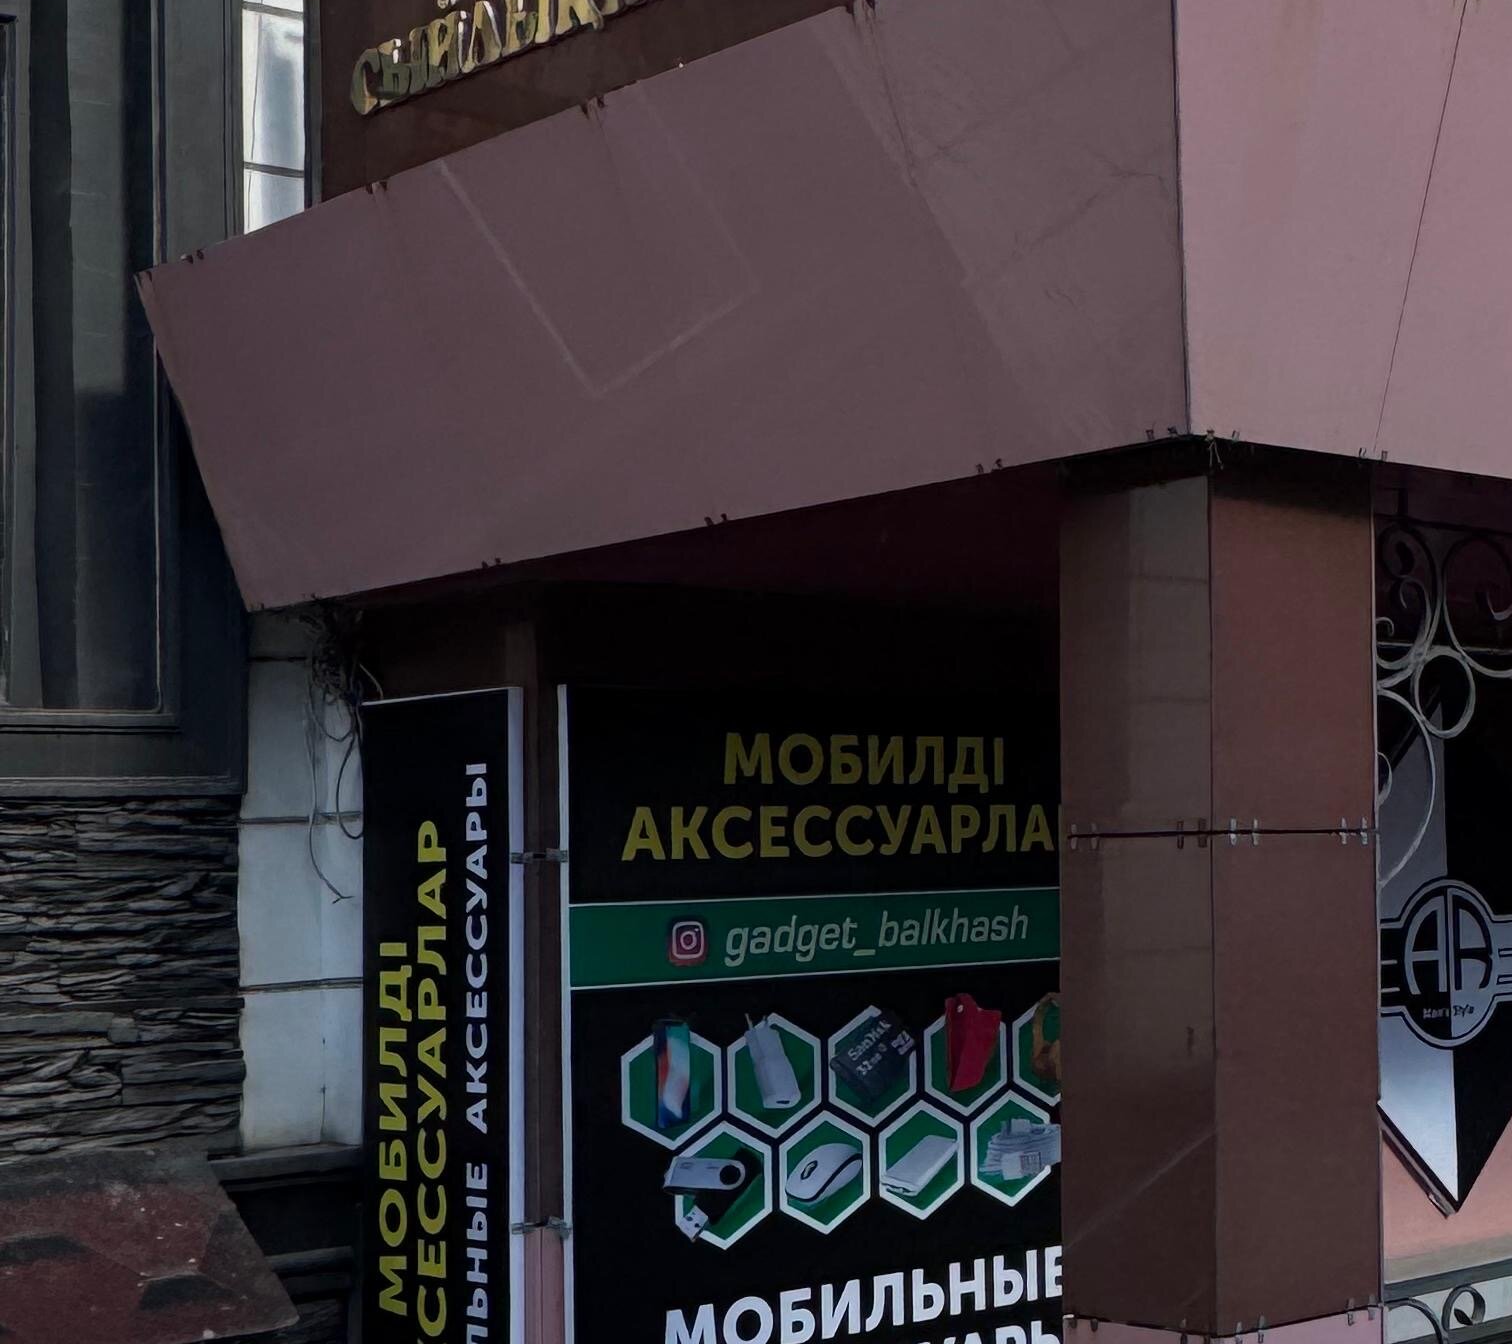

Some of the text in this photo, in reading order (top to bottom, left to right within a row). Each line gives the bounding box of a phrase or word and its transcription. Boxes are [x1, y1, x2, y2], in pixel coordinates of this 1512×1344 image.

[723, 731, 1005, 793] МОБИЛДІ
[622, 803, 1061, 862] АКСЕССУАРЛА
[465, 762, 488, 1135] АКСЕССУАРЫ
[724, 905, 1029, 968] gadget_balkhash
[377, 940, 413, 1317] МОБИЛДІ
